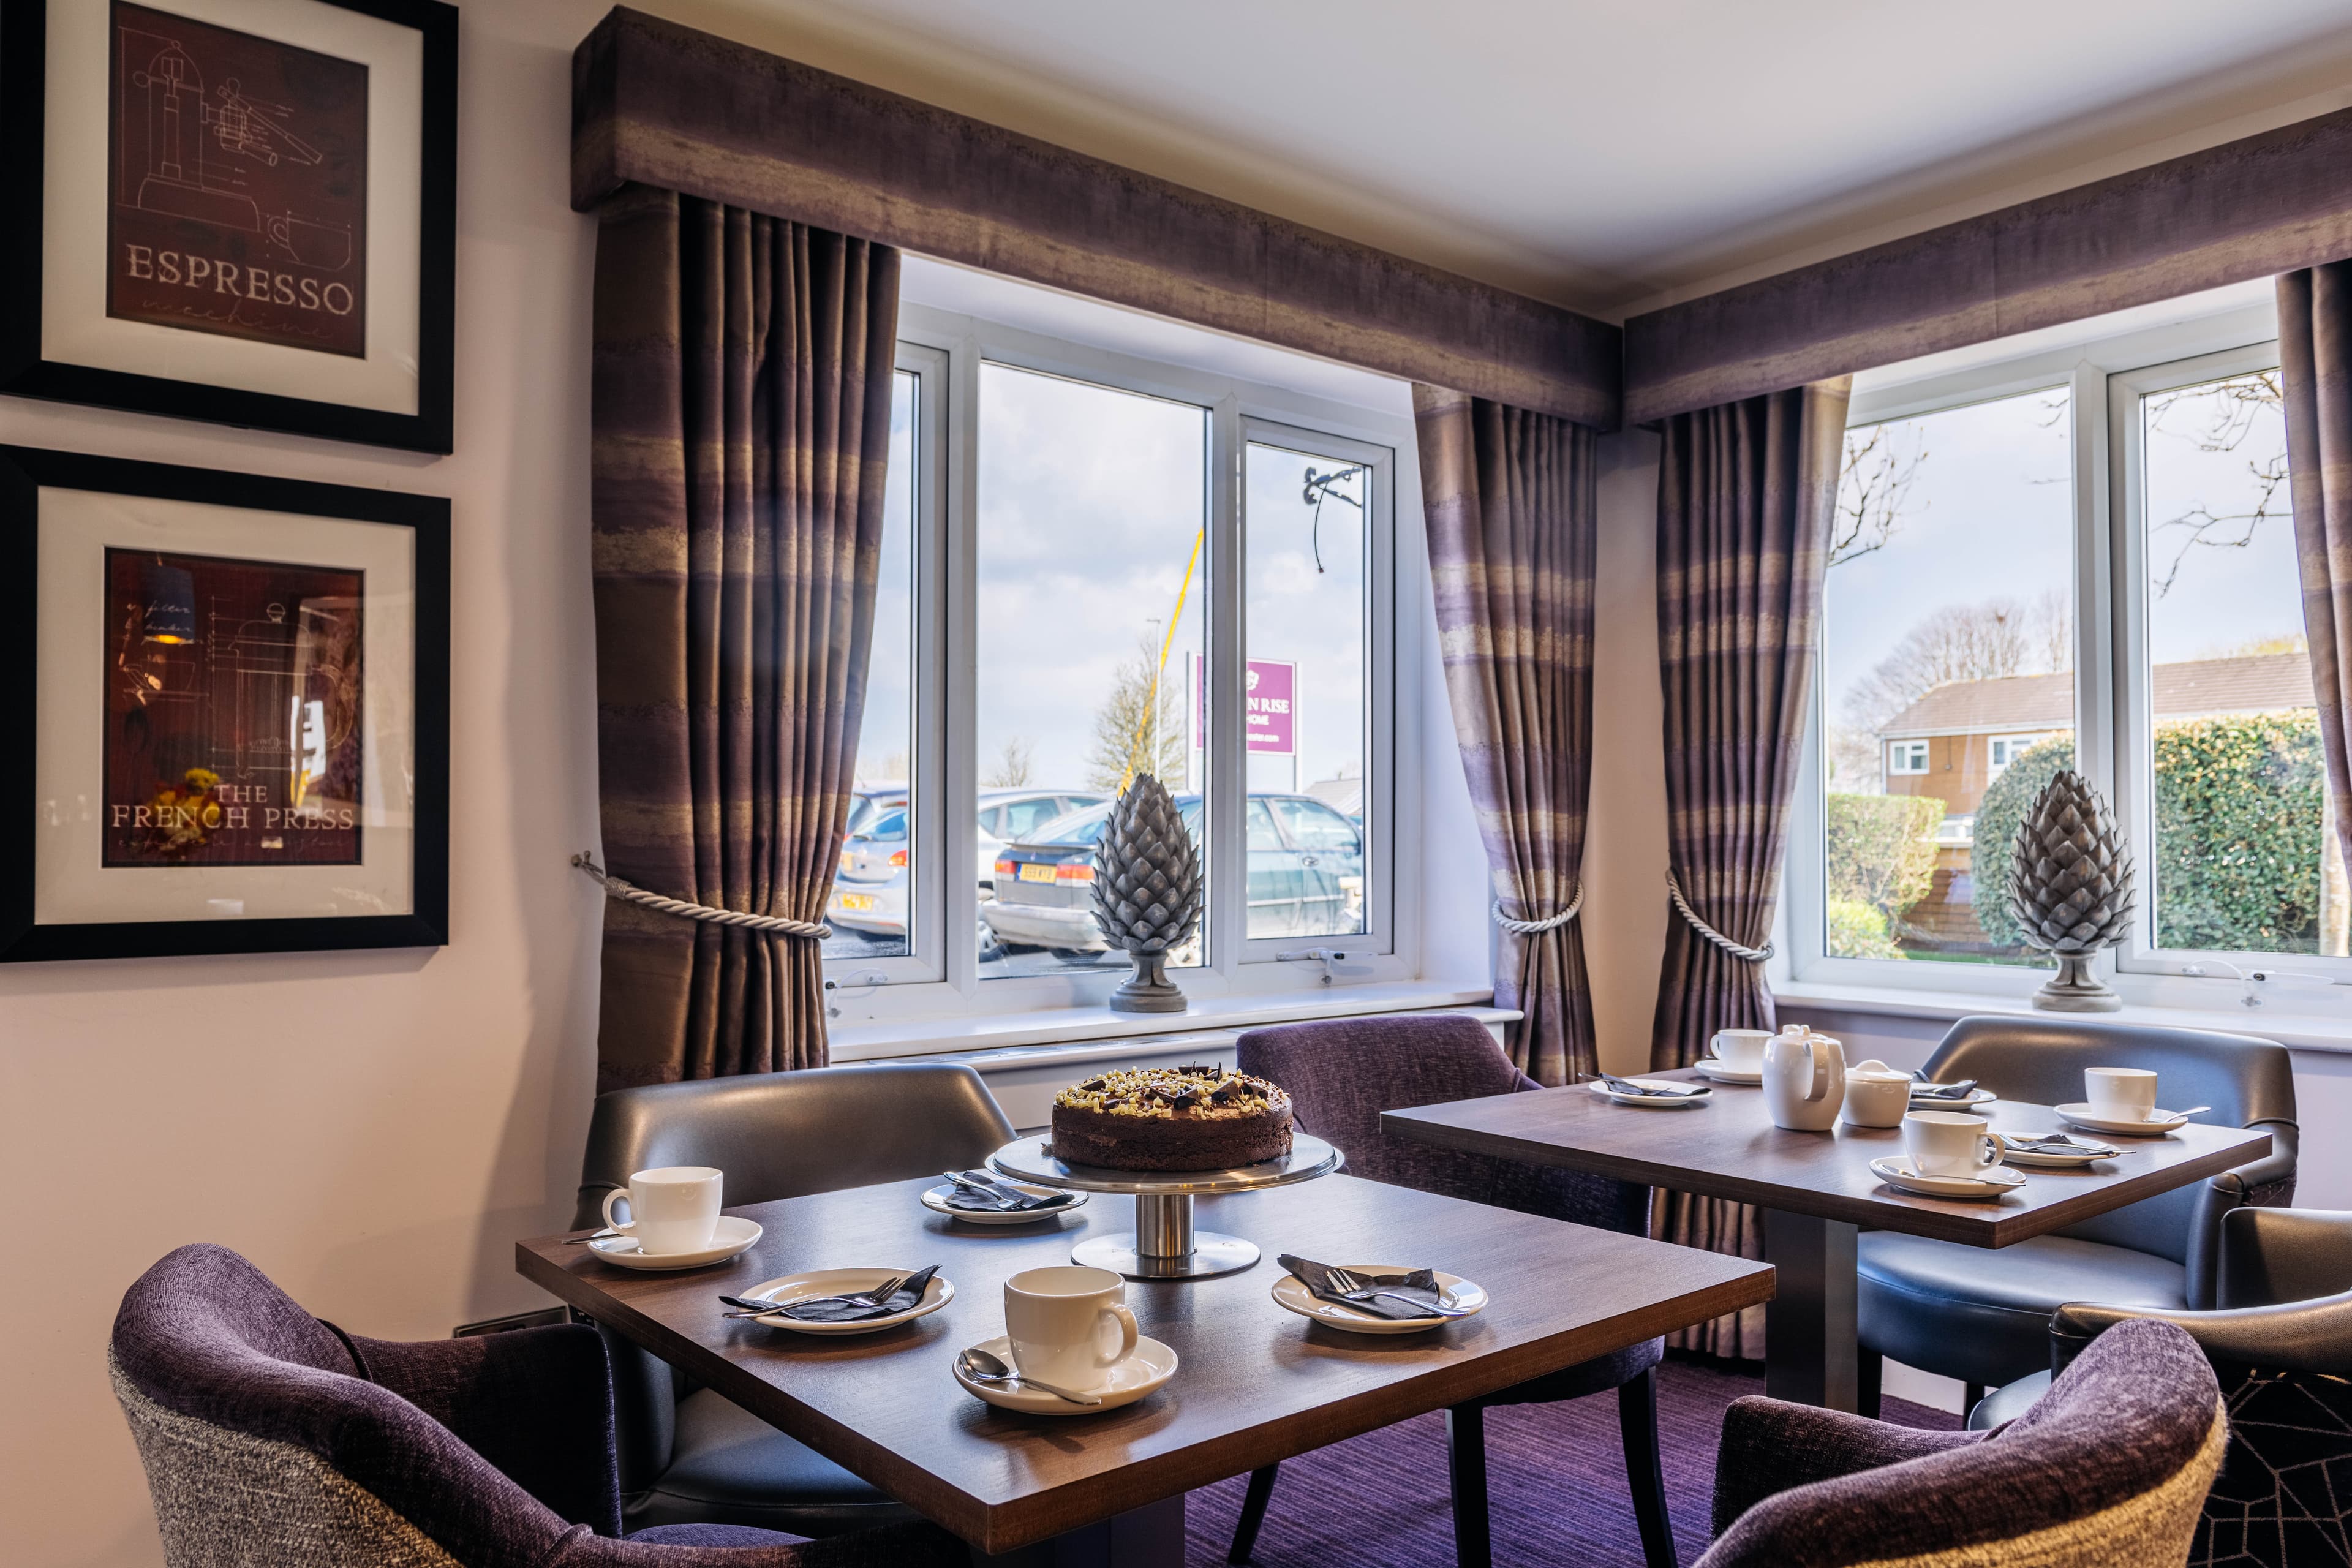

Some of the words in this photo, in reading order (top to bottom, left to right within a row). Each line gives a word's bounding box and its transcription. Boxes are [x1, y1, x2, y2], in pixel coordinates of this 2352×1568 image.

[126, 244, 353, 315] ESPRESSO
[1247, 697, 1259, 711] N
[1261, 698, 1289, 714] RISE
[214, 785, 268, 804] THE
[111, 805, 250, 829] FRENCH
[264, 807, 353, 831] PRESS
